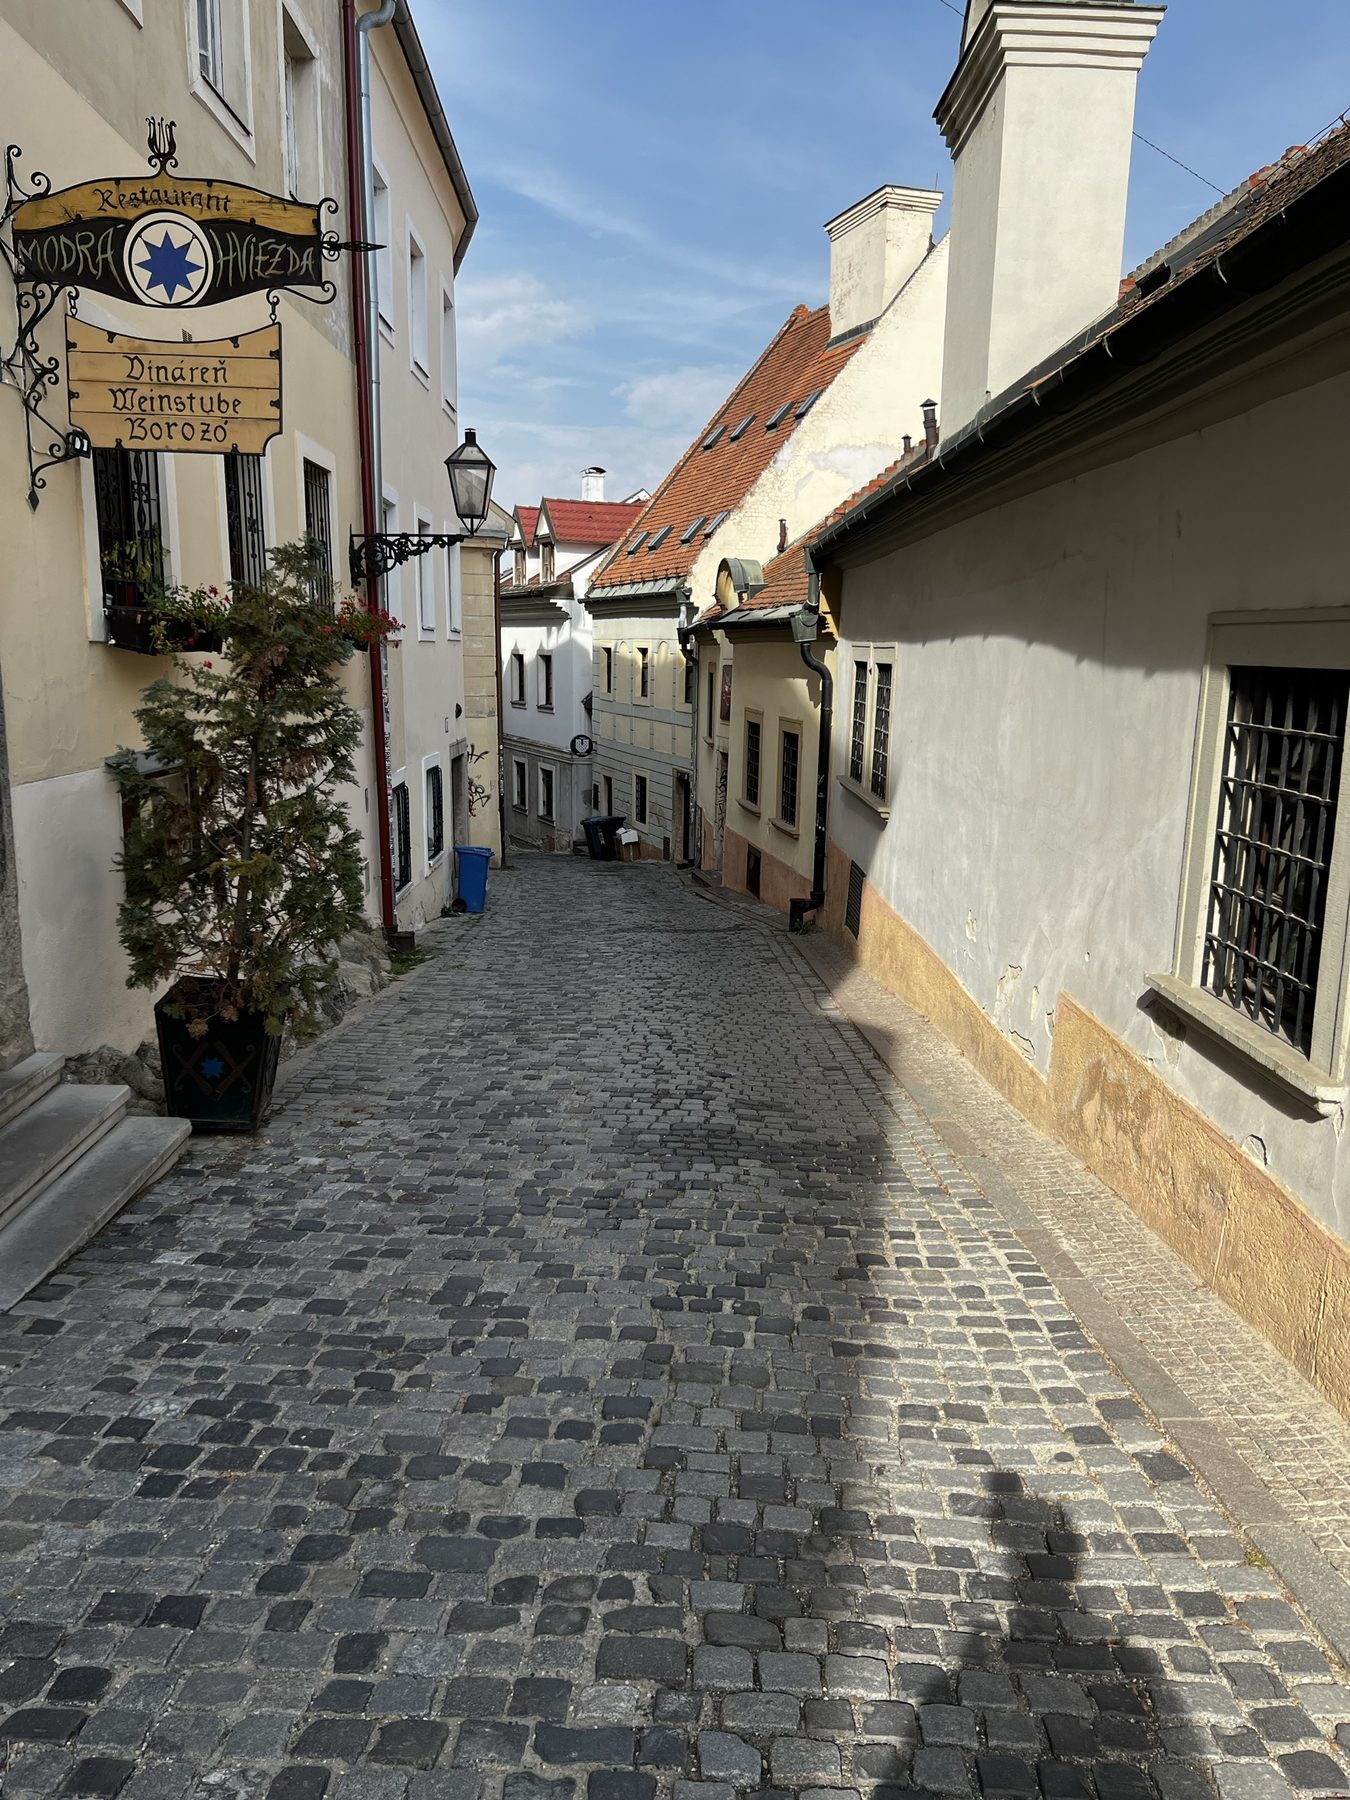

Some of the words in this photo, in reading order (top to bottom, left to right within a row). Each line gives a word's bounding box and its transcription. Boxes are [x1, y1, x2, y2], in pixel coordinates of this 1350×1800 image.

[92, 186, 231, 215] Restaurant
[17, 223, 128, 293] MODRÁ
[122, 355, 228, 384] Vináreň
[109, 387, 242, 414] Weinstube
[125, 417, 228, 443] Borozó
